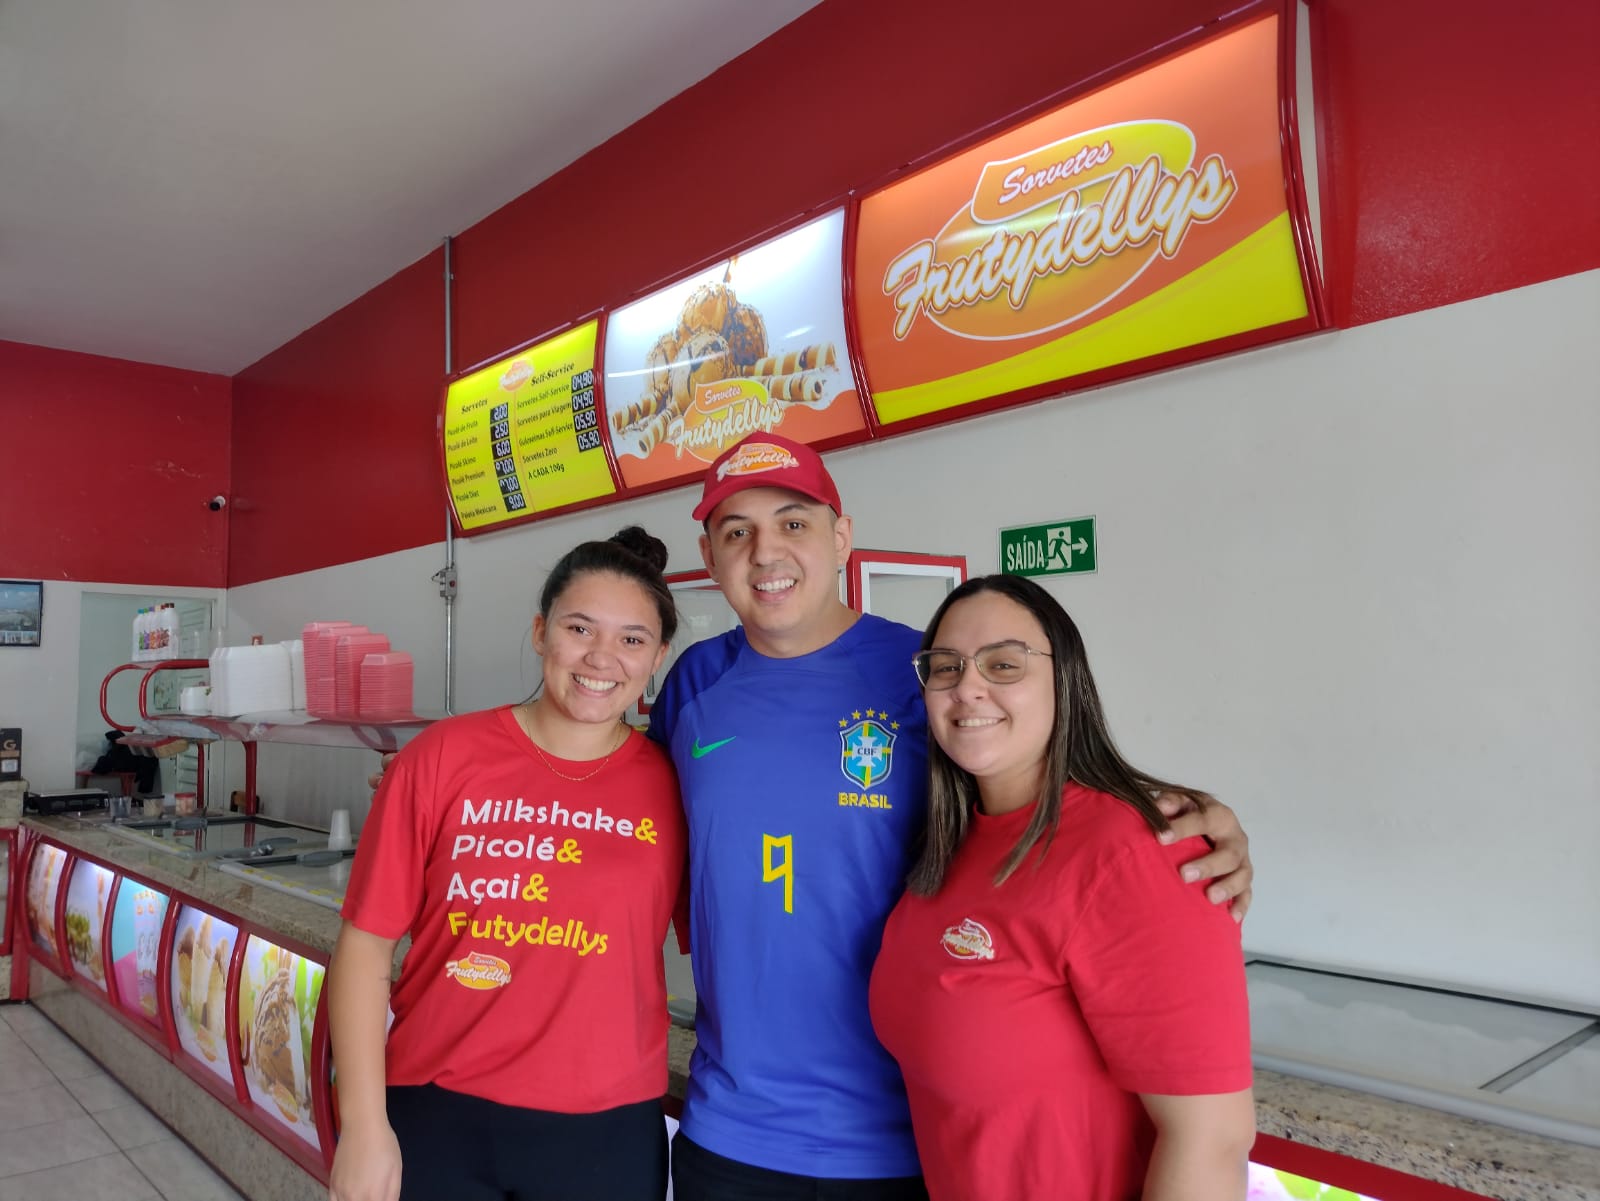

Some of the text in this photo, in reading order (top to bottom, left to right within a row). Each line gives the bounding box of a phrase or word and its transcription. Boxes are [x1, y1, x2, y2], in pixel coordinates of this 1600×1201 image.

[999, 141, 1114, 204] Sorvetes
[884, 155, 1236, 339] Frutydellys
[531, 362, 575, 386] Self-Service
[704, 385, 742, 405] Sorvetes
[668, 401, 784, 458] Frutydellys
[545, 447, 558, 456] Zero
[533, 466, 550, 478] CADA
[550, 463, 565, 473] 100g
[1006, 535, 1045, 571] SAÍDA
[857, 747, 877, 756] CBF
[838, 792, 892, 809] BRASIL
[762, 833, 793, 914] 9
[445, 960, 512, 988] Frutydellys
